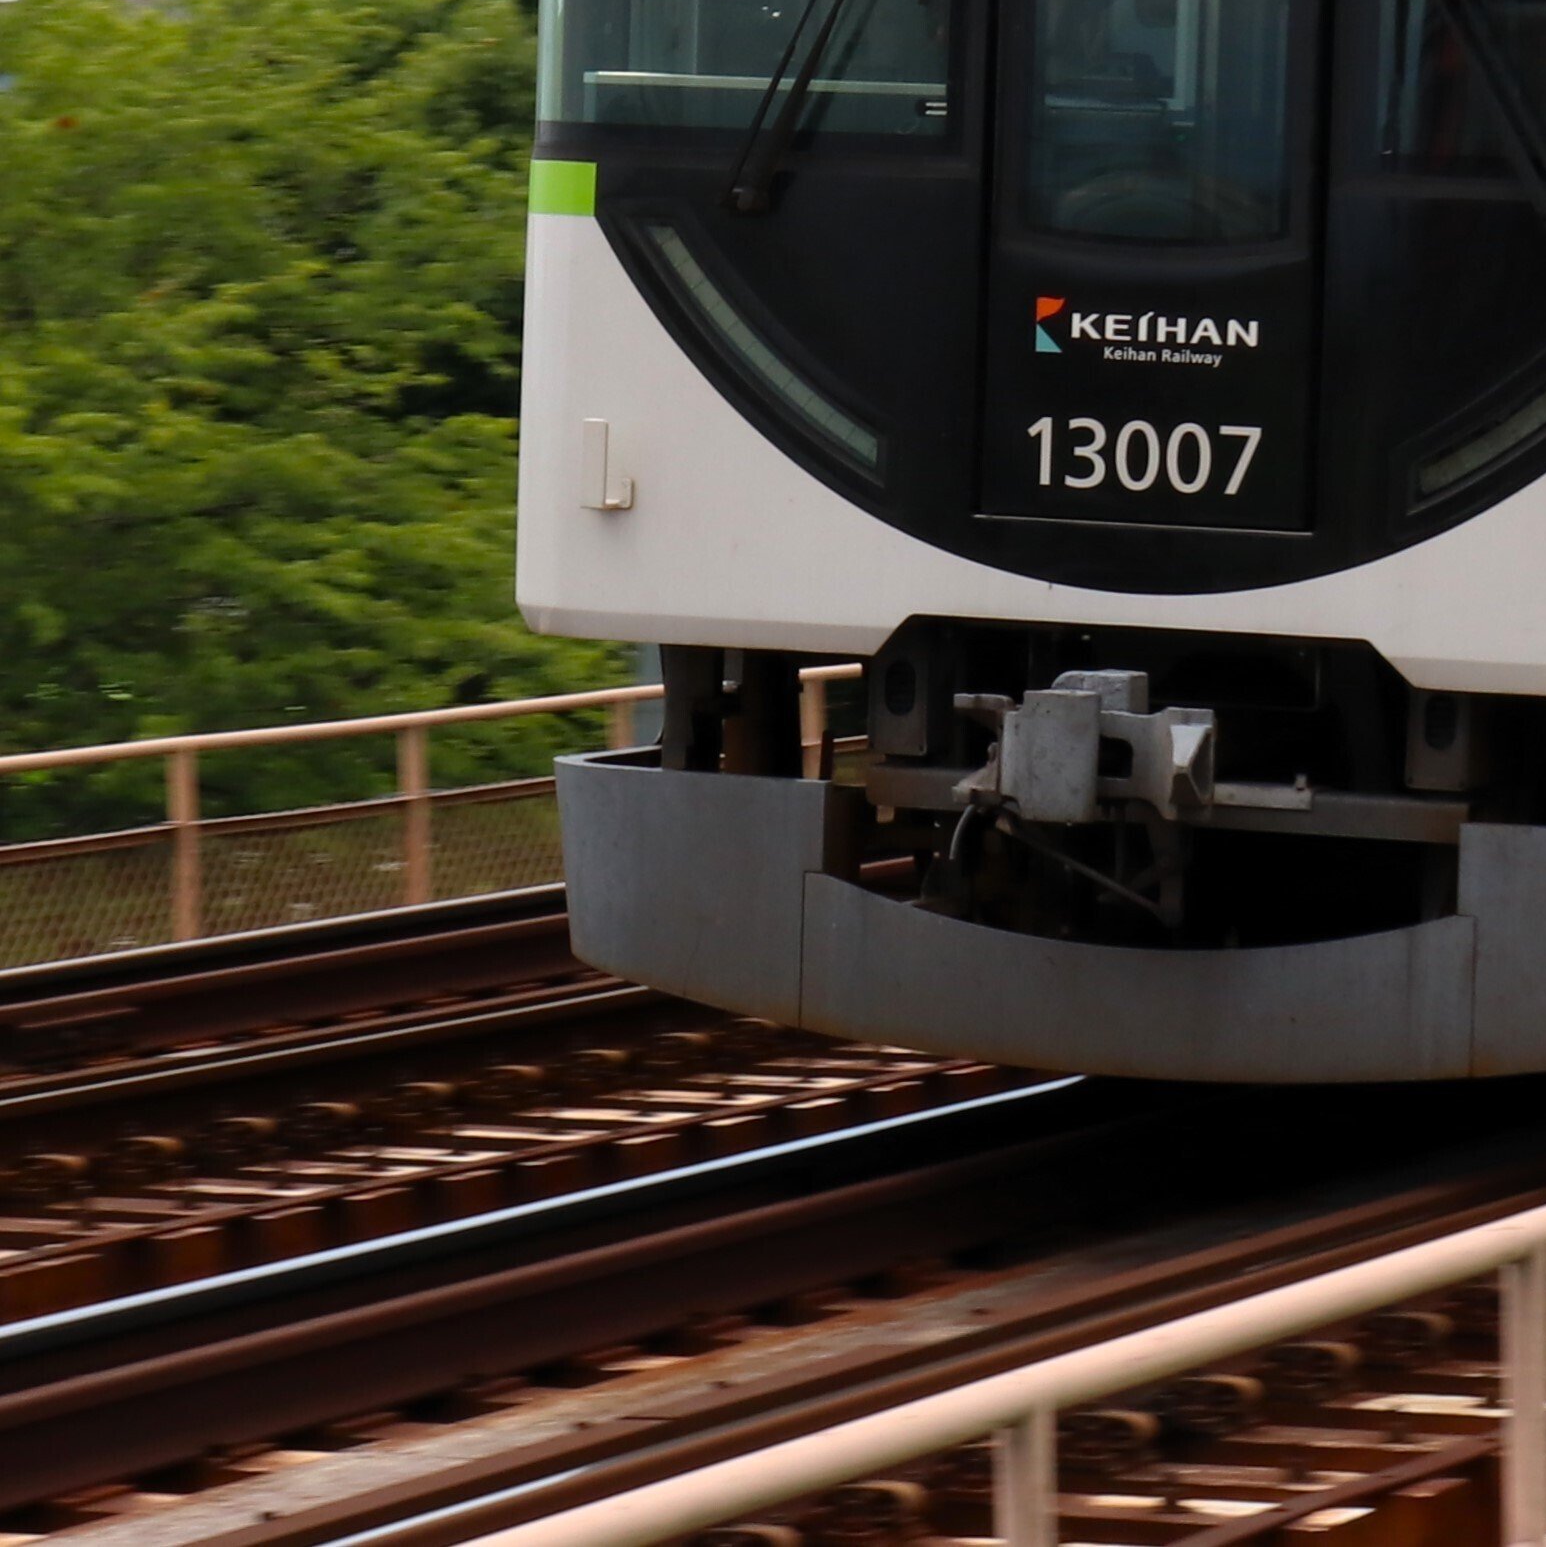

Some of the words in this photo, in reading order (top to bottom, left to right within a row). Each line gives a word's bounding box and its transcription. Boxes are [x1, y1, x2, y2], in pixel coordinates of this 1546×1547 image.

[1070, 311, 1260, 348] KEIHAN
[1103, 345, 1157, 363] Keihan
[1161, 349, 1223, 368] Railway
[1026, 415, 1263, 496] 13007
